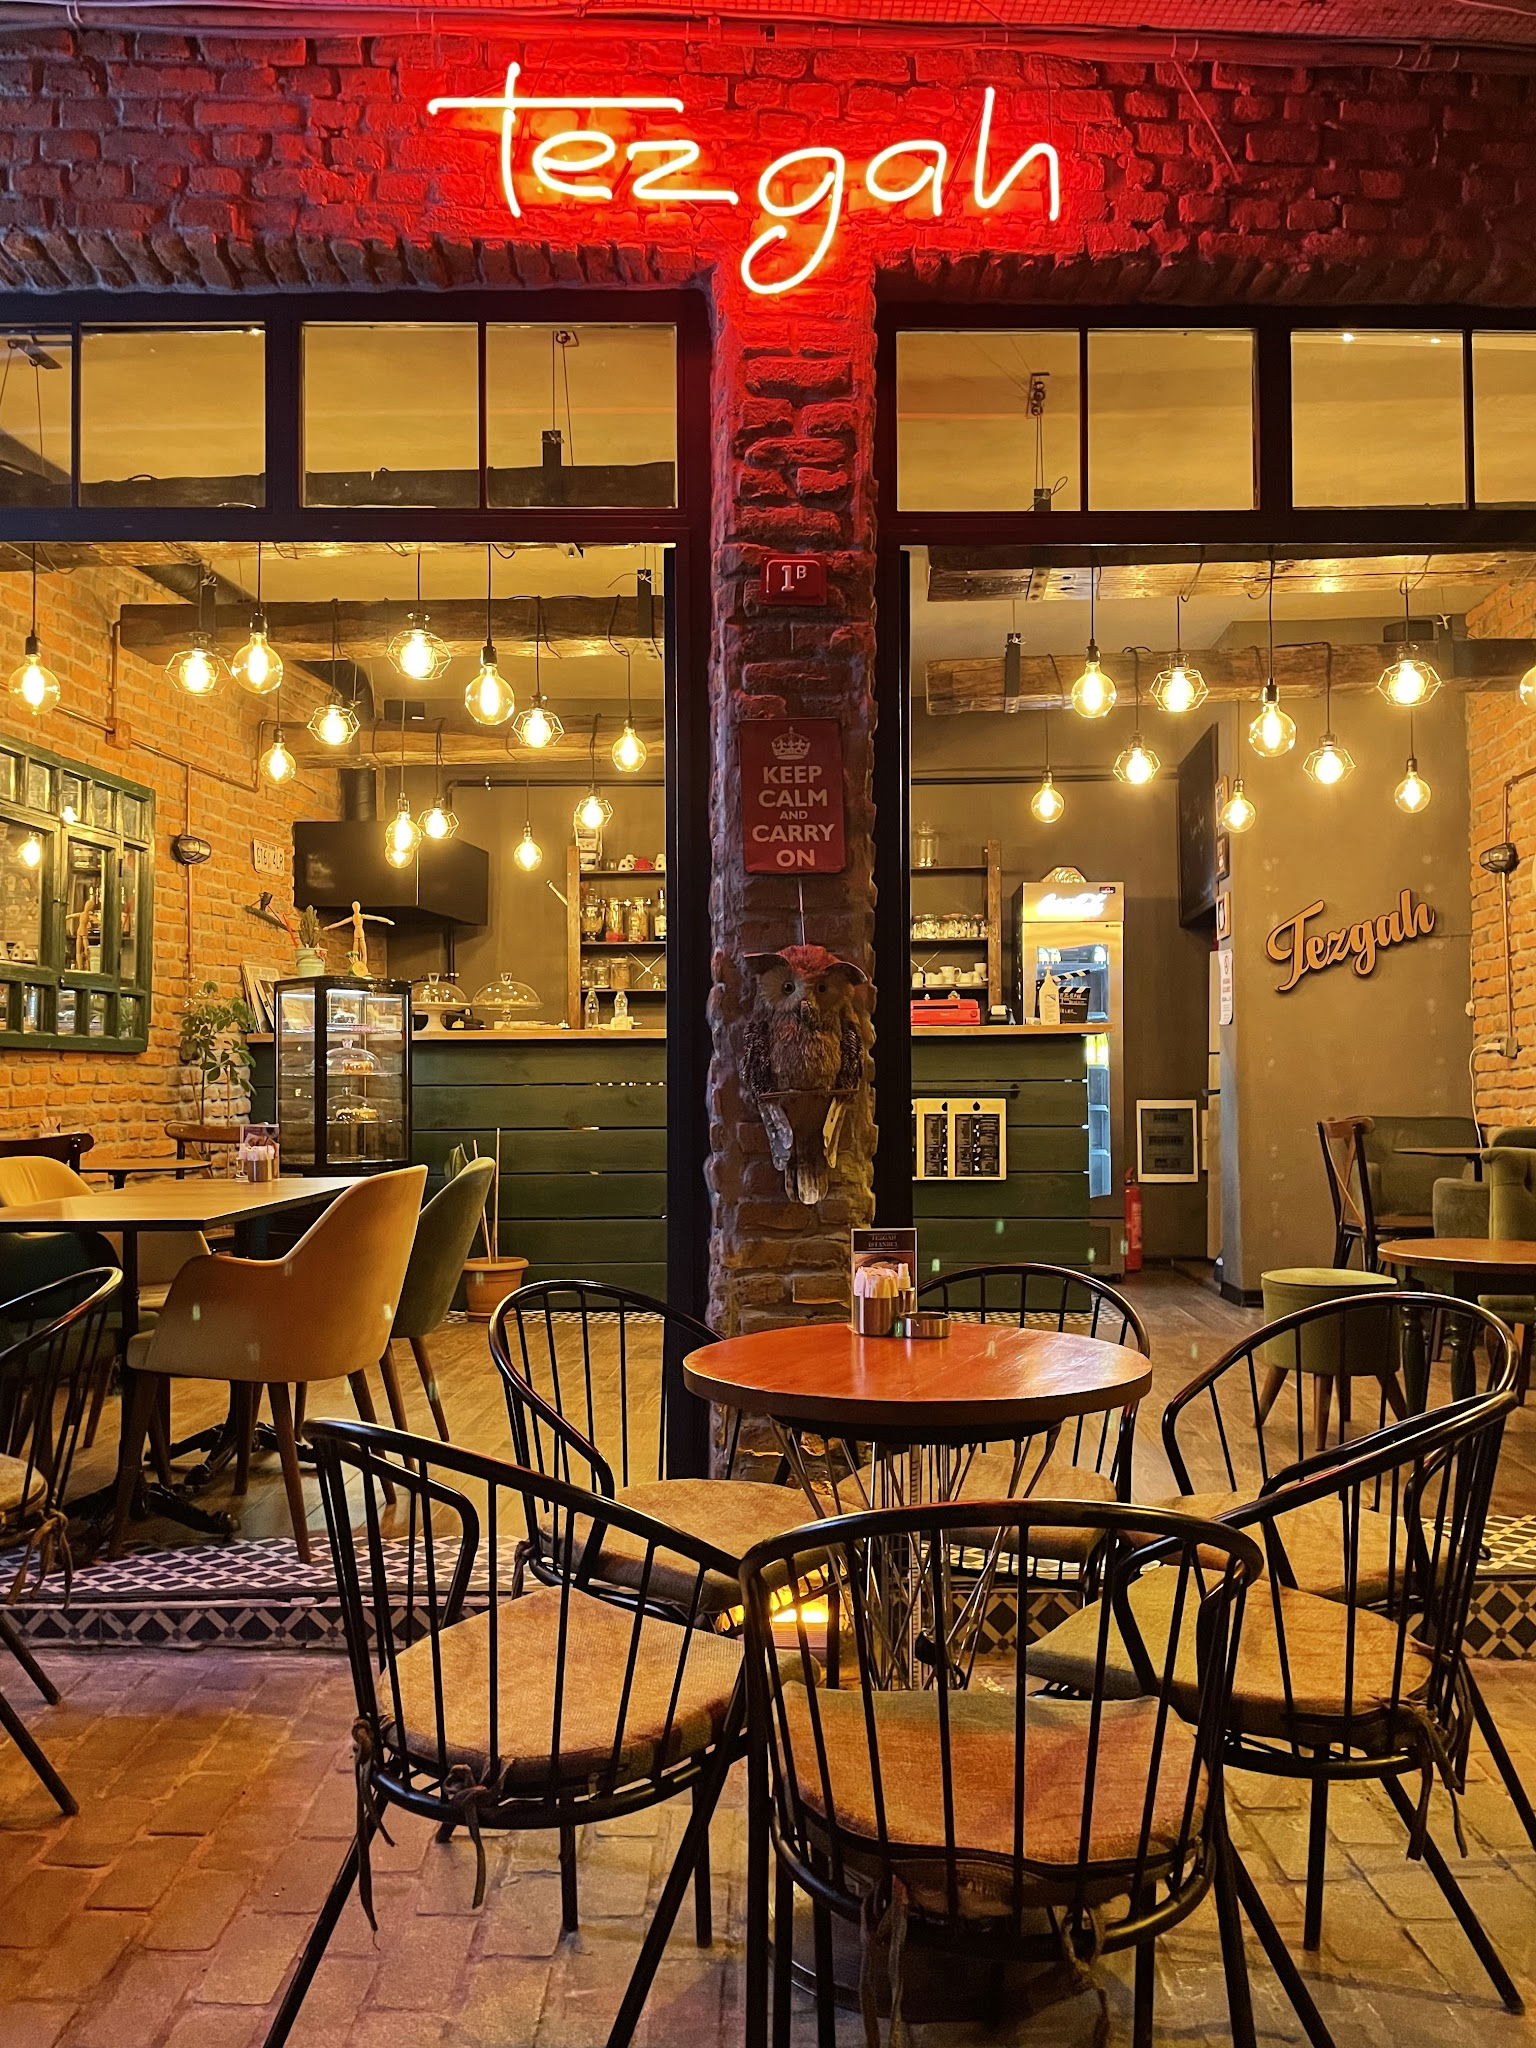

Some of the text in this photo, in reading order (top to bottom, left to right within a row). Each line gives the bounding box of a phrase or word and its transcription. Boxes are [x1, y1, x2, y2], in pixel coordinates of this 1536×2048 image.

[763, 765, 823, 784] KEEP
[757, 788, 829, 807] CALM
[779, 809, 808, 821] AND
[751, 823, 836, 843] CARRY
[775, 849, 816, 867] ON
[1265, 888, 1436, 993] Tezgah
